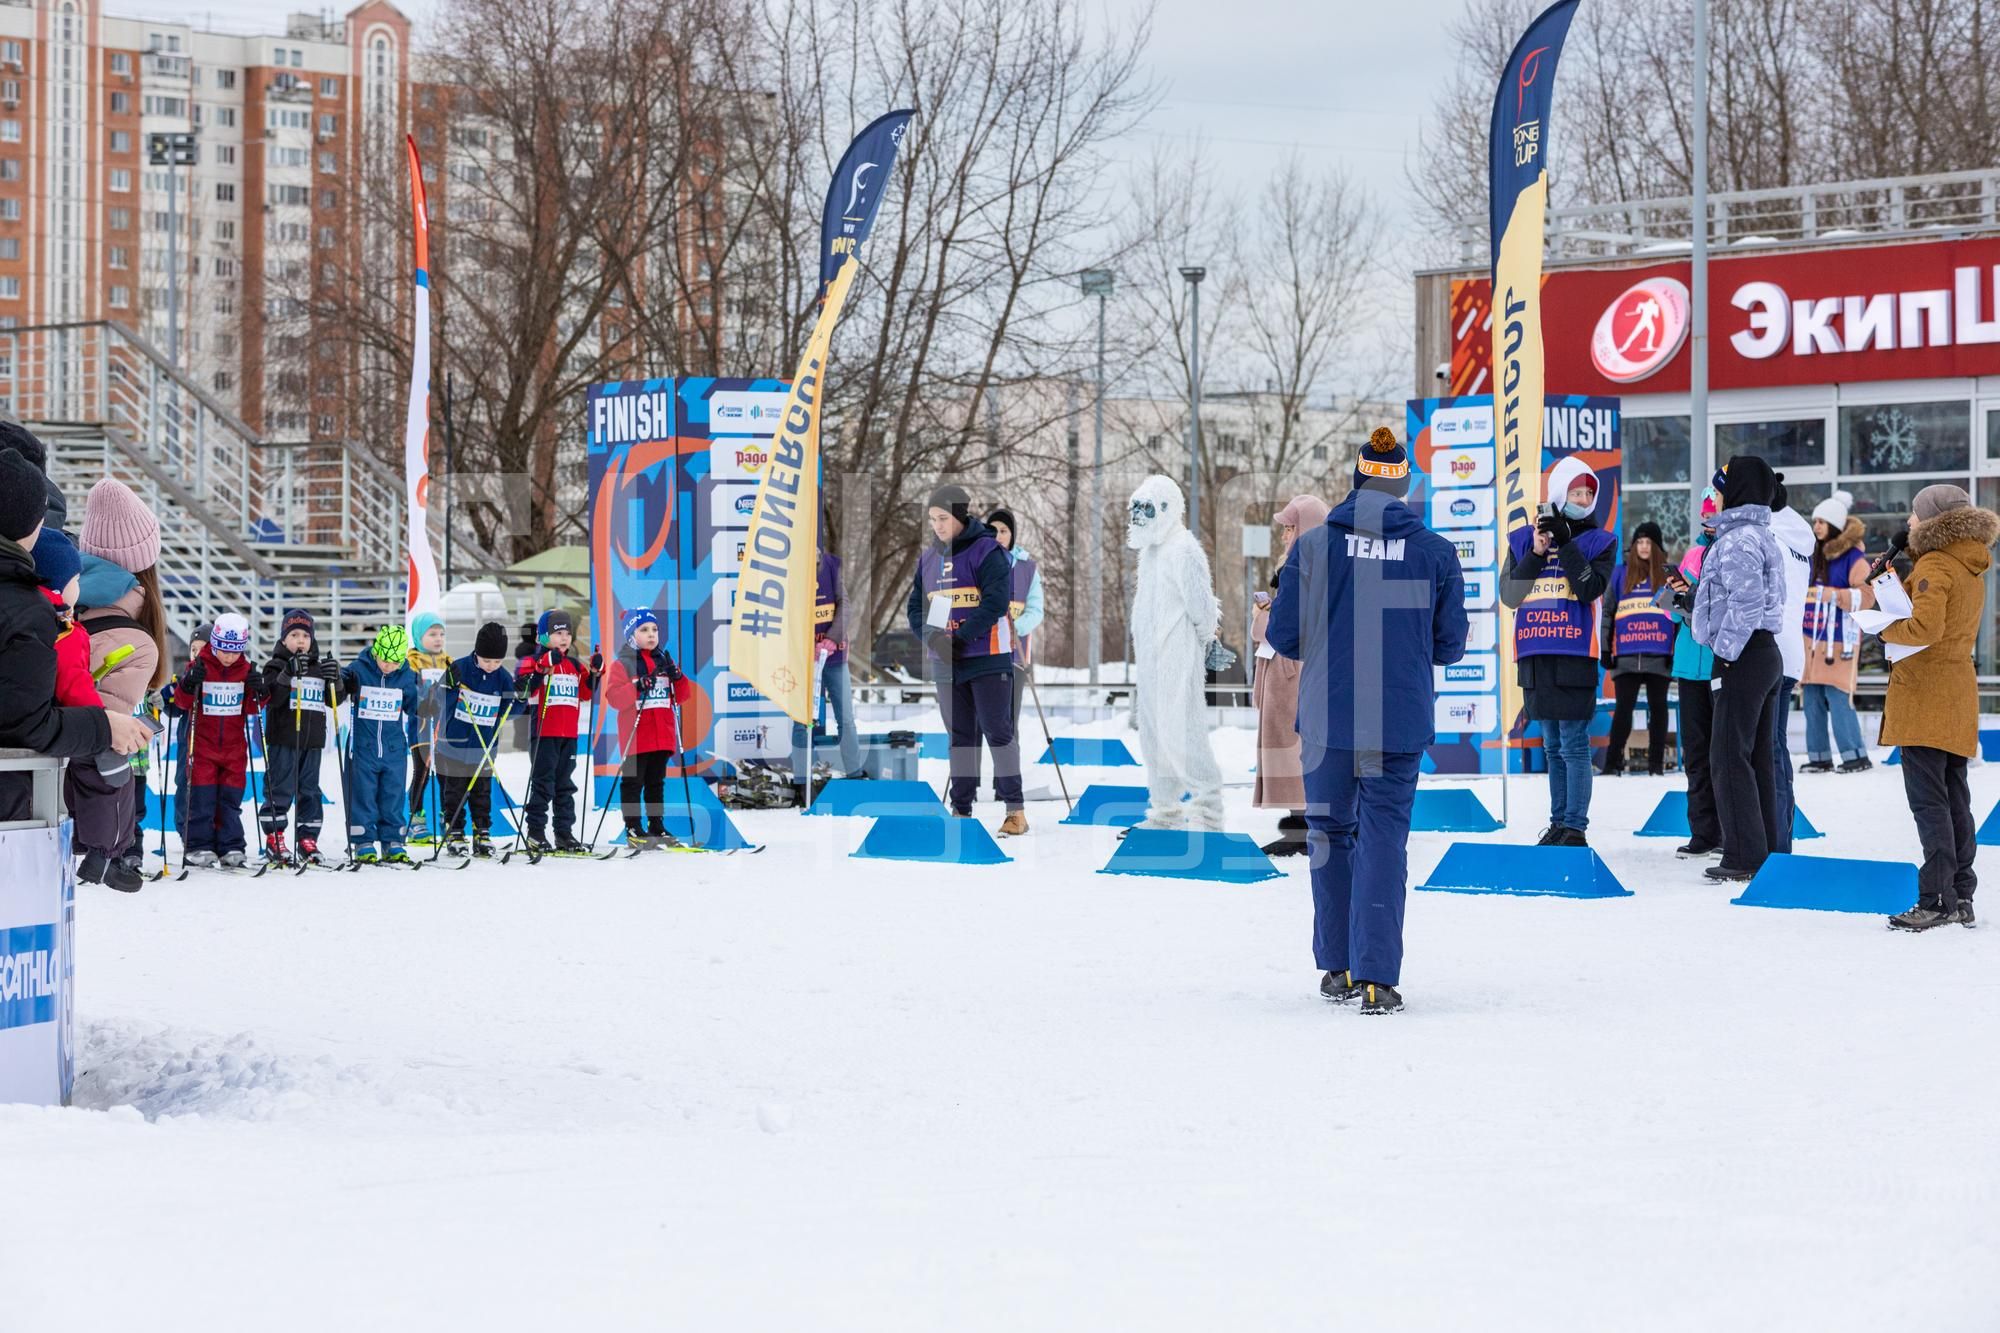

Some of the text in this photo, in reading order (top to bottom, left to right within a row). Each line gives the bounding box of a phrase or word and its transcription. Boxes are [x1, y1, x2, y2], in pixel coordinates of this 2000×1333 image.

[594, 391, 667, 443] FINISH
[1544, 406, 1612, 450] INISH
[1345, 533, 1406, 561] TEAM
[1526, 610, 1568, 624] СУДЬЯ
[1627, 621, 1659, 631] СУДЬЯ
[1518, 625, 1582, 641] ВОЛОНТЁР
[301, 687, 323, 701] 1013
[554, 684, 575, 696] 1031
[647, 687, 667, 698] 025
[212, 692, 238, 705] 1003
[370, 699, 393, 710] 1136
[734, 734, 756, 742] СБР
